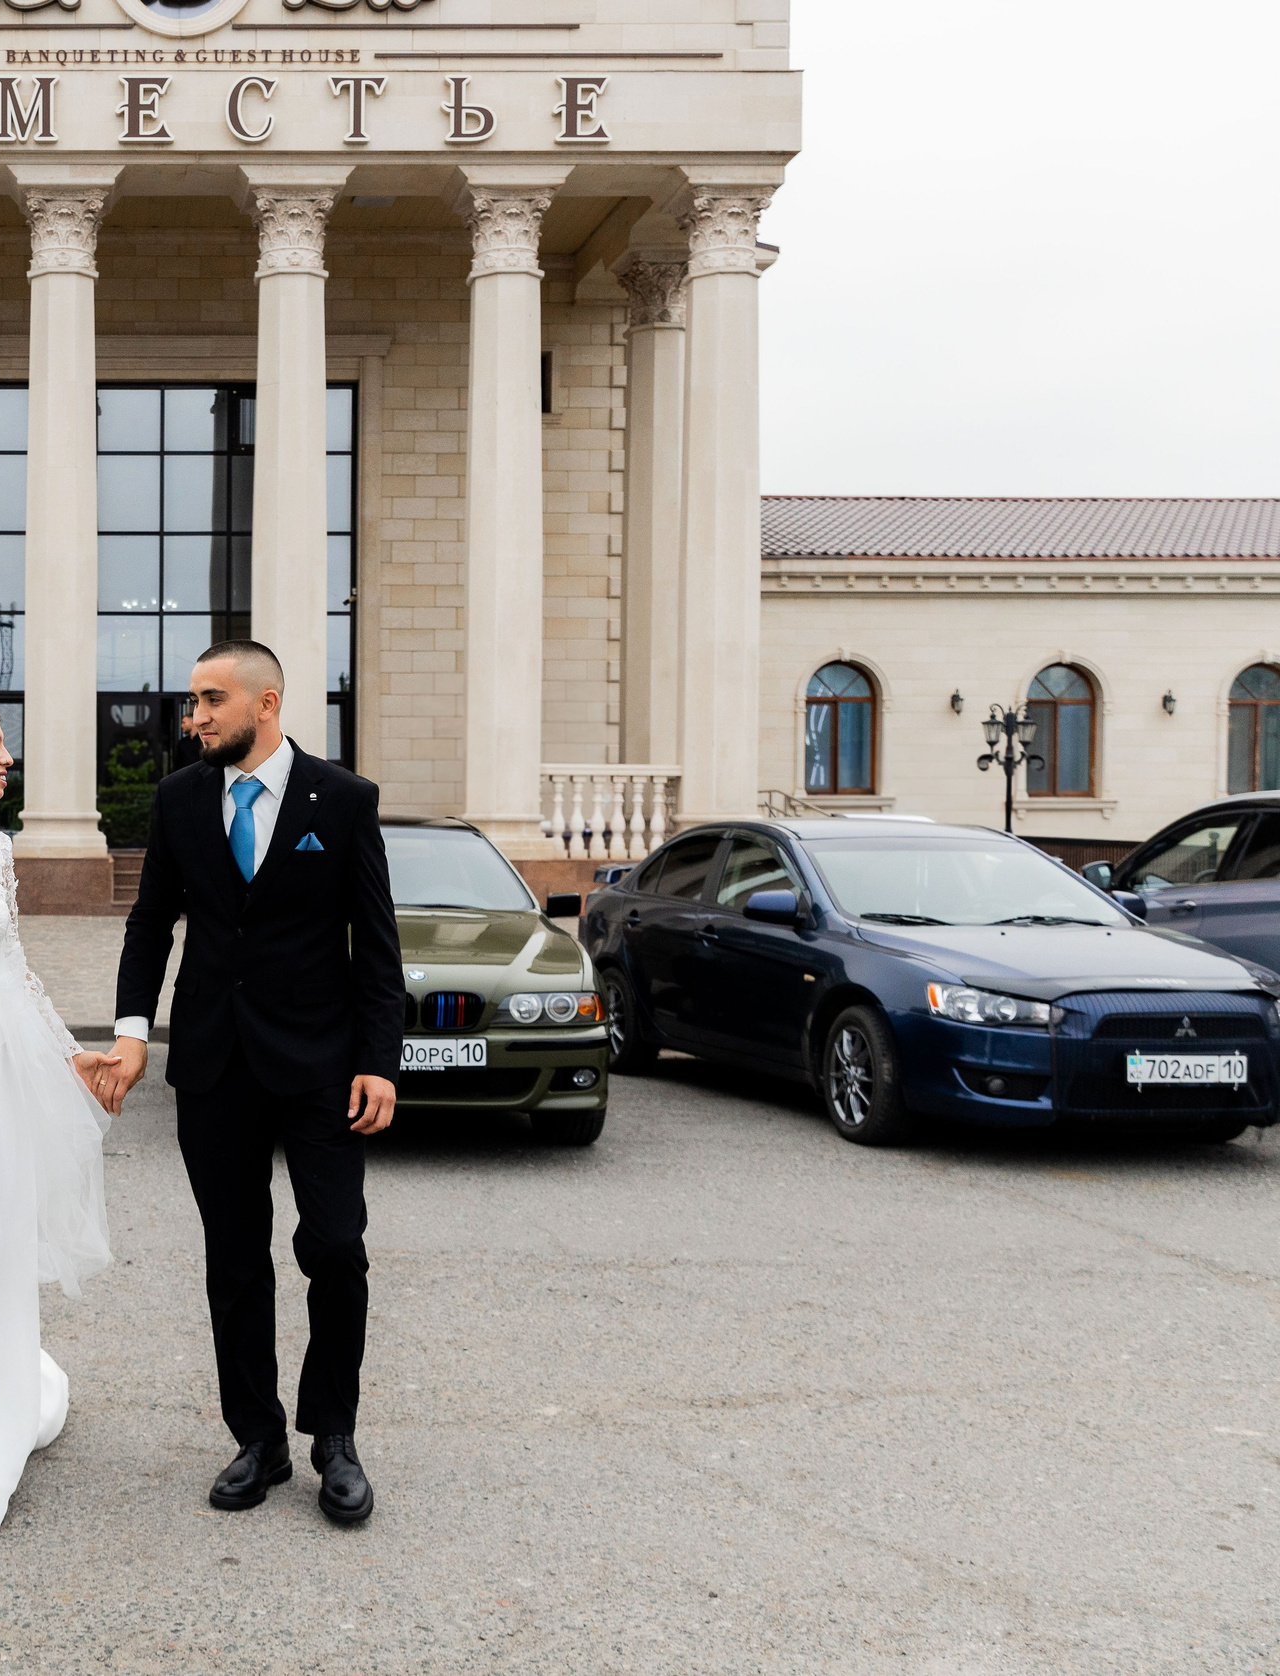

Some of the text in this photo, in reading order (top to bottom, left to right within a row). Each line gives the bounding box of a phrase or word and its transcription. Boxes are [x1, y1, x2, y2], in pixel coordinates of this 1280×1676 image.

[6, 49, 361, 66] BANQUETING & GUEST HOUSE
[402, 1043, 484, 1063] 0OPG 10
[1146, 1059, 1245, 1079] 702ADF 10
